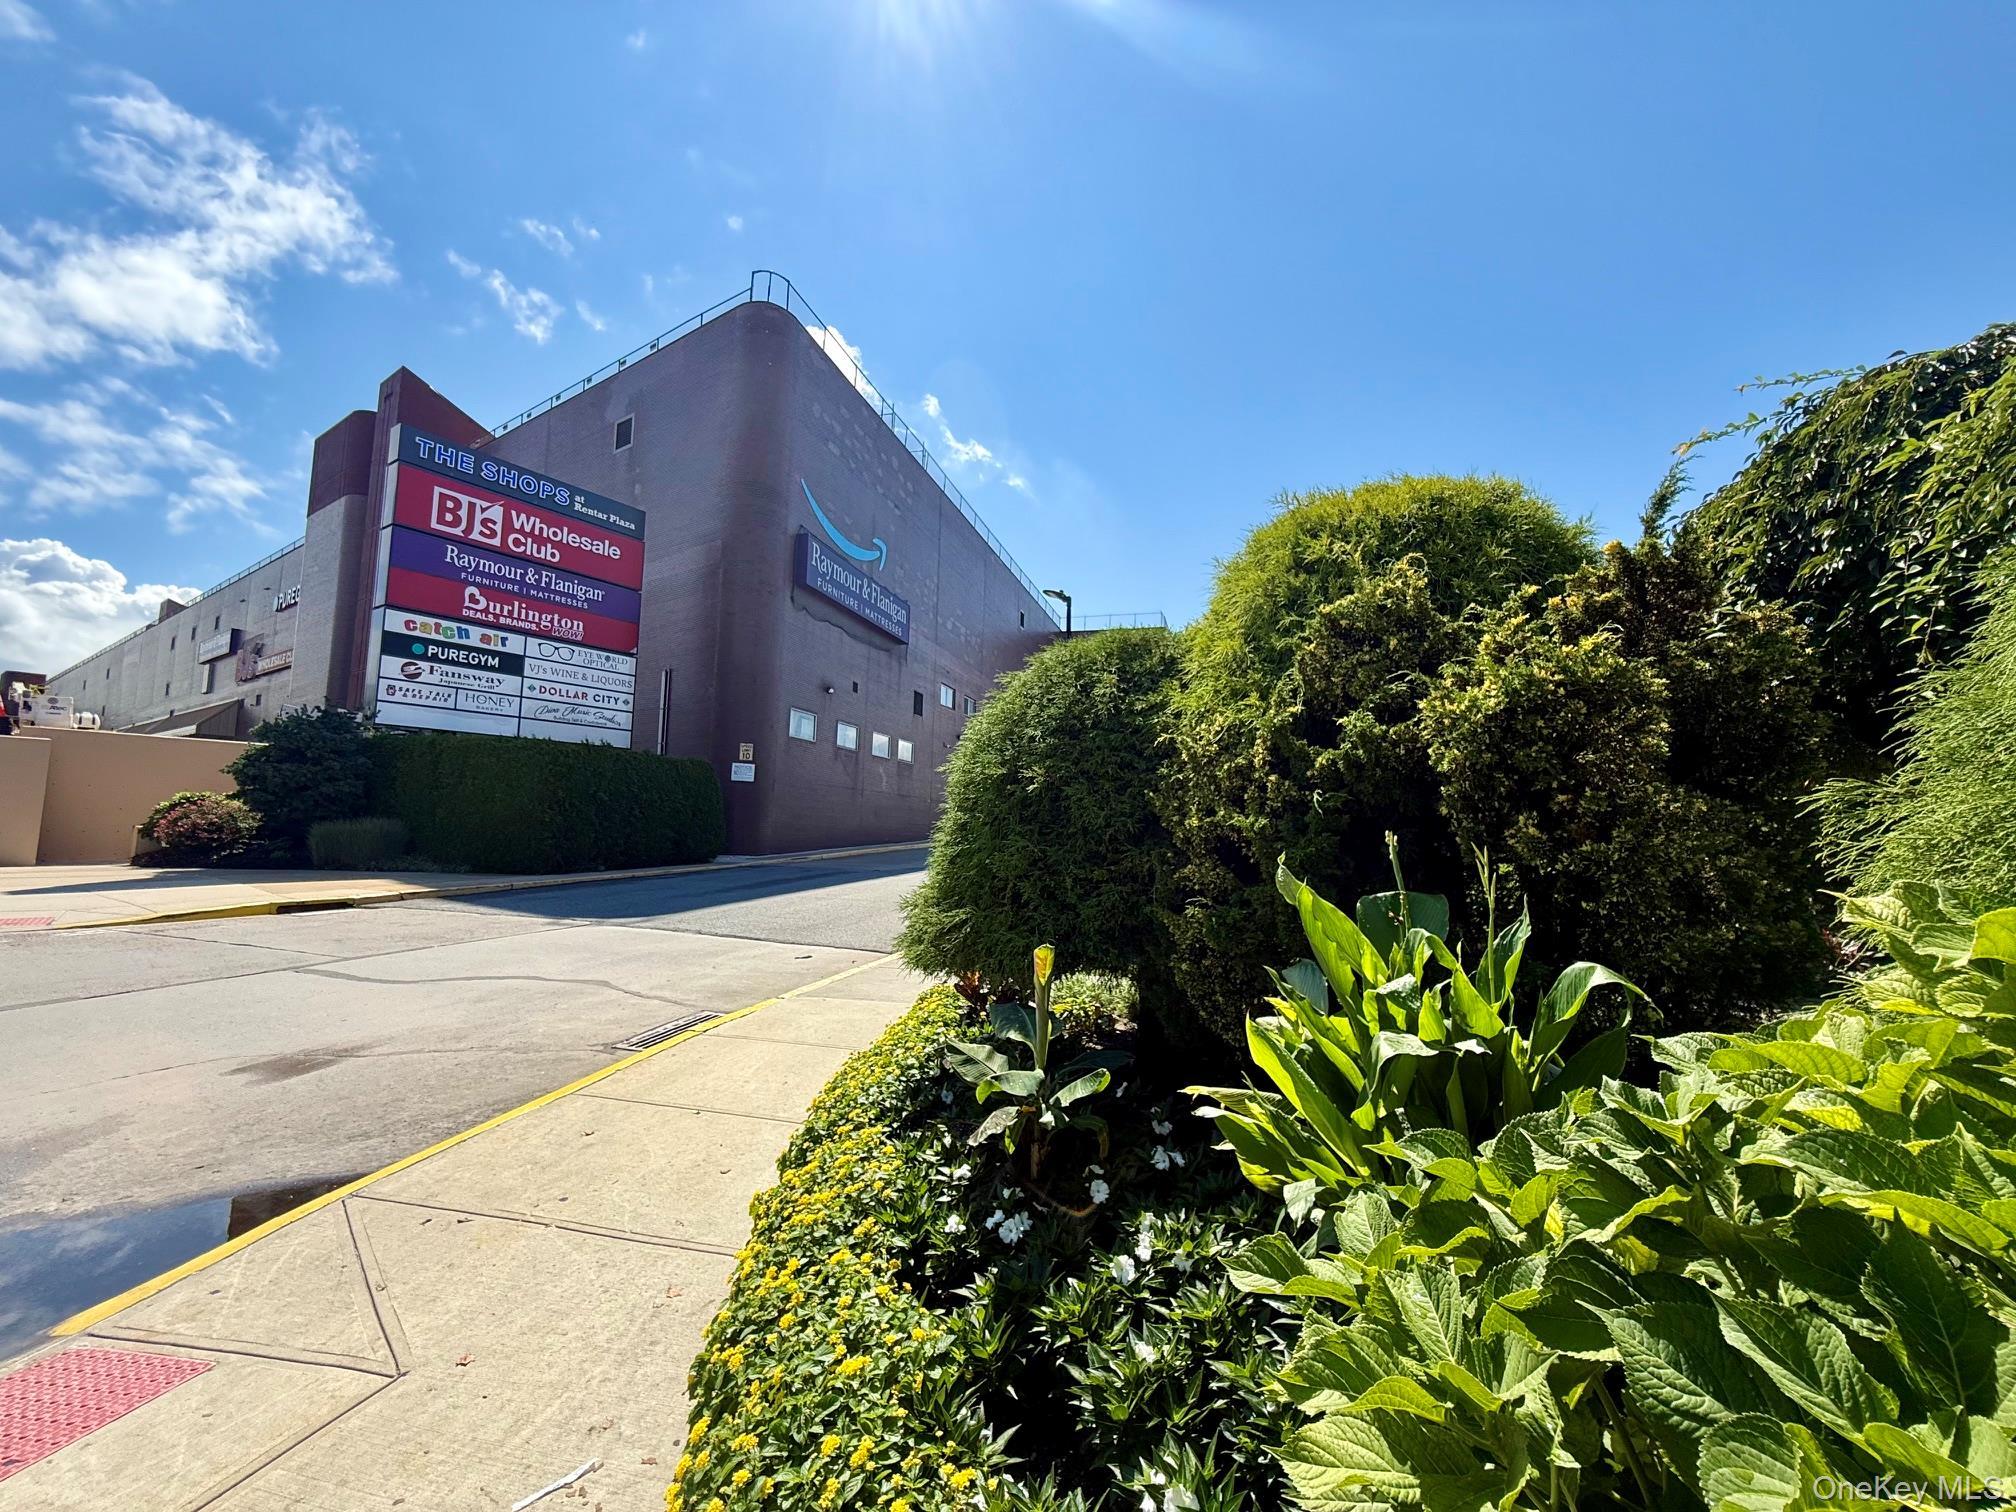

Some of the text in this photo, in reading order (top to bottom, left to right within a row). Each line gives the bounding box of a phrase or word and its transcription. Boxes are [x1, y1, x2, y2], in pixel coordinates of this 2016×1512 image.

[415, 436, 571, 506] THE SHOPS
[574, 493, 585, 504] at
[574, 502, 636, 530] Rentar Plaza
[507, 533, 561, 563] Club
[511, 509, 621, 560] Wholesale
[444, 544, 604, 602] Raymour & Flanigan
[812, 541, 907, 624] Raymour & Flanigan
[461, 572, 588, 609] FURNITURE MATTRESSES
[463, 586, 585, 632] Burlington
[817, 578, 902, 636] FURNITURE MATTRESSES
[404, 618, 509, 648] catch air
[462, 608, 585, 641] DEALS. BRANDS. WOW!
[427, 645, 499, 668] PUREGYM
[577, 650, 594, 659] EYE
[582, 659, 620, 671] OPTICAL
[428, 664, 506, 688] Fansway
[529, 663, 633, 689] VJ's WINE & LIQUORS
[465, 692, 515, 708] HONEY
[538, 685, 620, 706] DOLLAR CITY
[742, 752, 750, 760] 10
